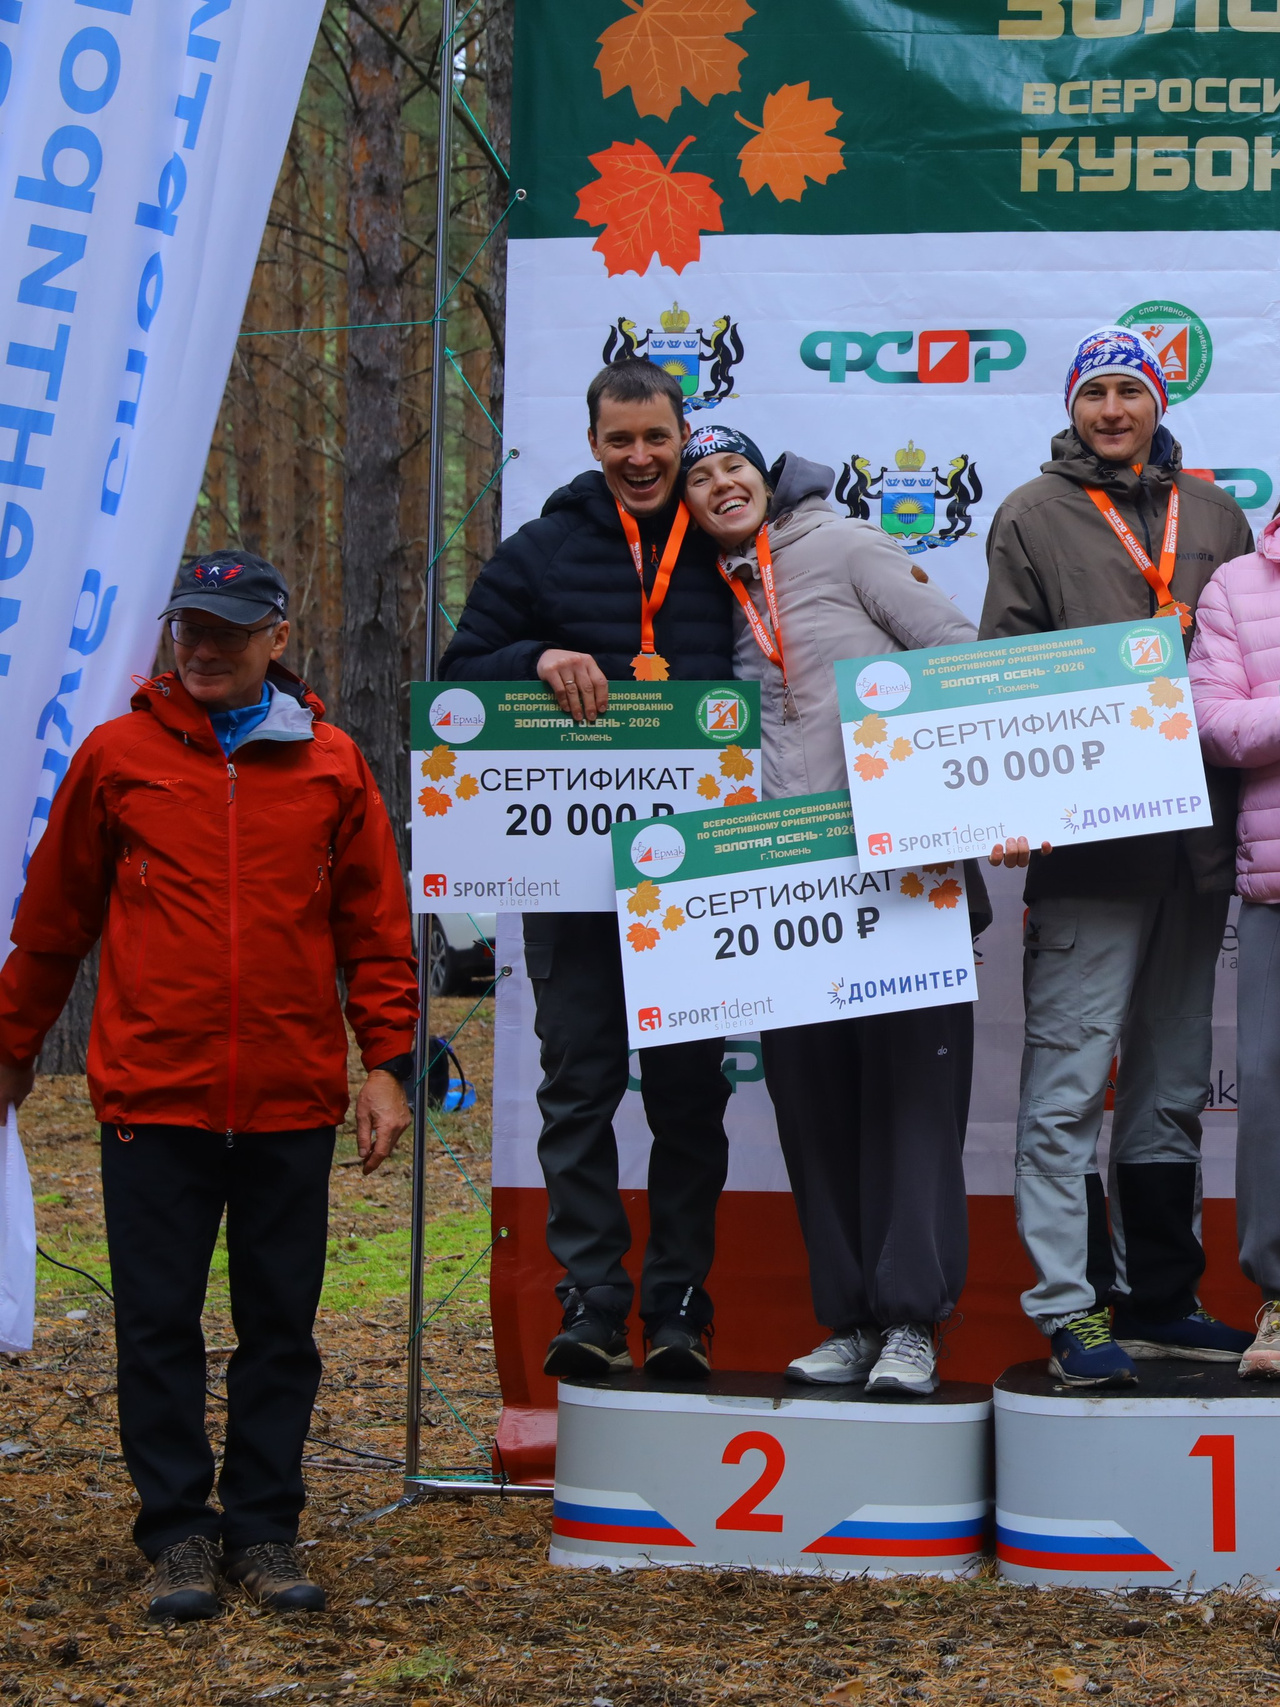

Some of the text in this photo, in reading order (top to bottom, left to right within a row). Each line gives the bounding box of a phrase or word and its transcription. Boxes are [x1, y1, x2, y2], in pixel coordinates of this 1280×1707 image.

[1138, 305, 1192, 322] СПОРТИВНОГО
[1186, 325, 1208, 391] ОРИЕНТИРОВАНИЯ
[1109, 507, 1152, 569] ЗОЛОТАЯ ОСЕНЬ
[922, 647, 1096, 676] ПО СПОРТИВНОМУ ОРИЕНТИРОВАНИЮ
[928, 638, 1083, 665] ВСЕРОССИЙСКИЕ СОРЕВНОВАНИЯ
[879, 681, 912, 695] Ермак
[941, 673, 999, 688] ЗОЛОТАЯ
[1053, 661, 1085, 673] 2026
[988, 683, 1040, 695] г.Тюмень
[505, 692, 662, 701] ВСЕРОССИ ЕВНОВАНИЯ
[453, 715, 484, 726] Ермак
[514, 719, 572, 728] ЗОЛОТАЯ
[628, 717, 659, 727] 2026
[913, 702, 1124, 750] СЕРТИФИКАТ
[560, 733, 611, 742] г.Тюмень
[480, 767, 694, 790] СЕРТИФИКАТ
[942, 755, 989, 789] 30
[506, 803, 551, 835] 20
[697, 806, 853, 840] ПО СПОРТИВНОМУ ОРИЕНТИРОВАН
[703, 797, 851, 829] ВСЕРОССИЙСКИЕ СОРЕВНОВАНИ
[1082, 796, 1201, 829] ДОМИНТЕР
[714, 837, 772, 854] ЗОЛОТАЯ
[826, 822, 855, 837] 2026
[899, 823, 1006, 852] SPORTident
[946, 842, 986, 855] siberia
[654, 846, 686, 860] Ермак
[760, 847, 811, 860] г.Тюмень
[453, 876, 560, 895] SPORTident
[686, 868, 899, 919] СЕРТИФИКАТ
[499, 897, 539, 905] siberia
[714, 924, 759, 960] 20
[774, 912, 843, 950] 000
[848, 968, 967, 1004] ДОМИНТЕР
[668, 997, 773, 1027] SPORTident
[714, 1017, 754, 1030] siberia
[716, 1432, 785, 1533] 2
[1188, 1434, 1236, 1553] 1
